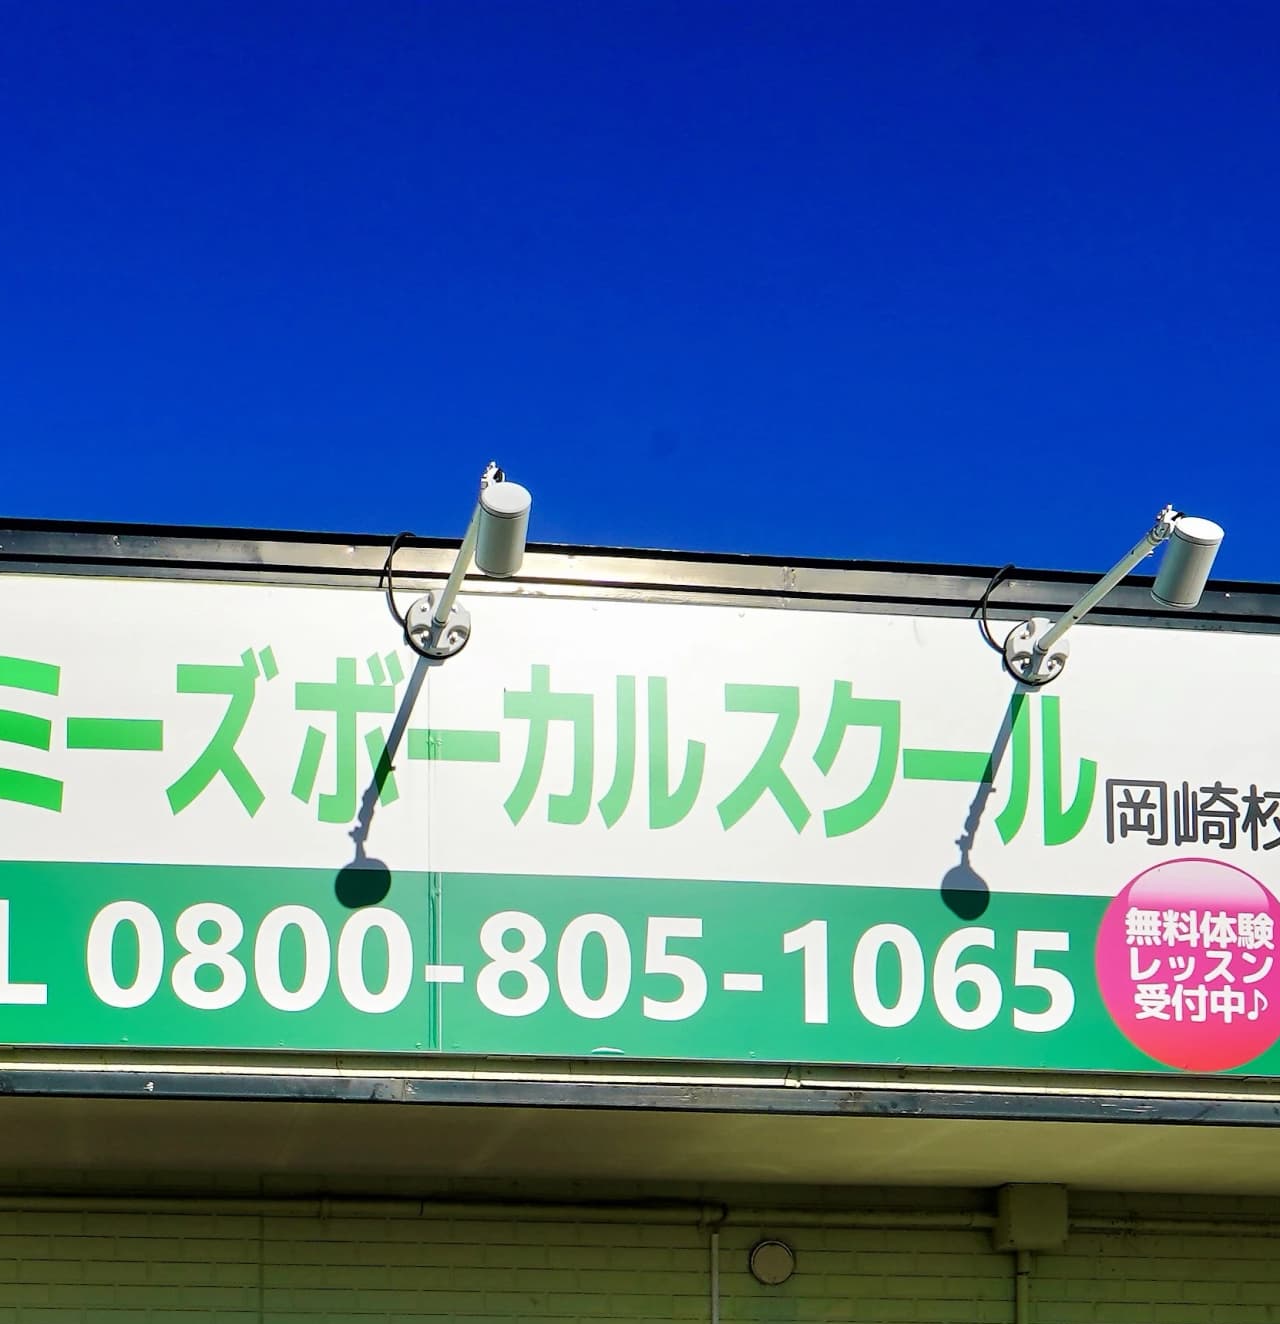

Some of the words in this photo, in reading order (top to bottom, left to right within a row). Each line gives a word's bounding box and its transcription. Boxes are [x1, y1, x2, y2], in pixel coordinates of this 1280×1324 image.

[1125, 907, 1275, 950] 無料体験
[86, 900, 1076, 1033] 0800-805-1065
[1130, 947, 1274, 984] レッスン
